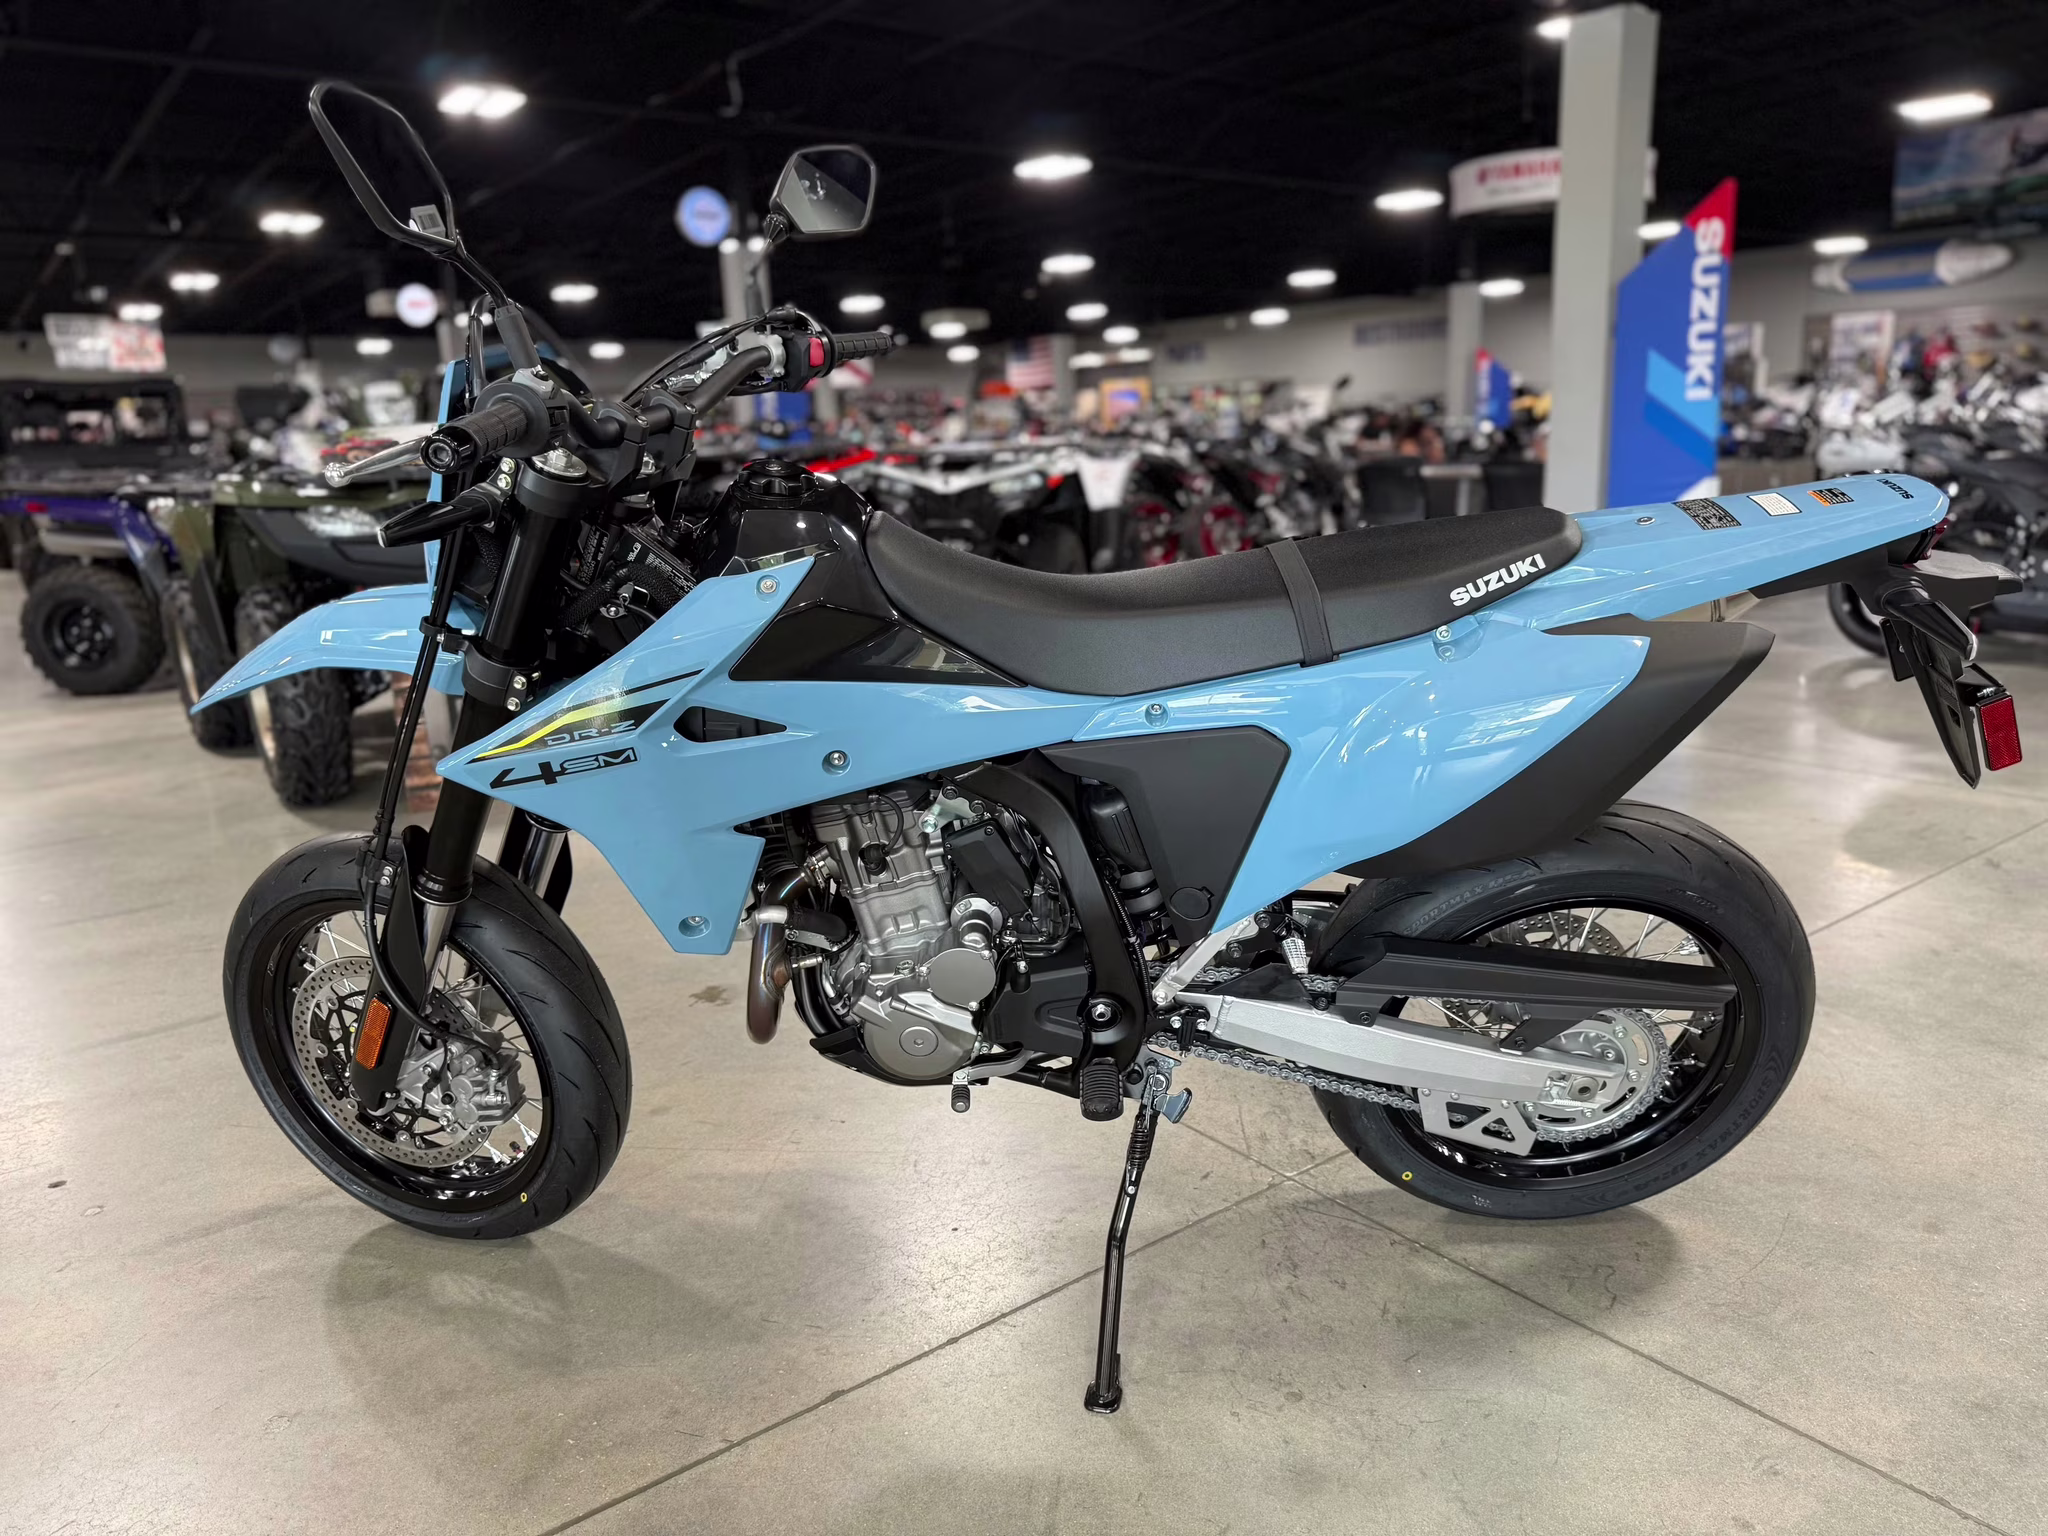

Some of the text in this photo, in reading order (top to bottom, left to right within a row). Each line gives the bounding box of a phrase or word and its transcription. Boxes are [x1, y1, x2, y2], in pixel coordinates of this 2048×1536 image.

[1684, 216, 1726, 402] SUZUKI
[1877, 478, 1914, 500] SUZUKI
[1449, 553, 1547, 607] SUZUKI
[543, 719, 636, 746] DR-Z
[1404, 883, 1484, 936] SPORTMAX
[1696, 1073, 1774, 1158] SPORTMAX
